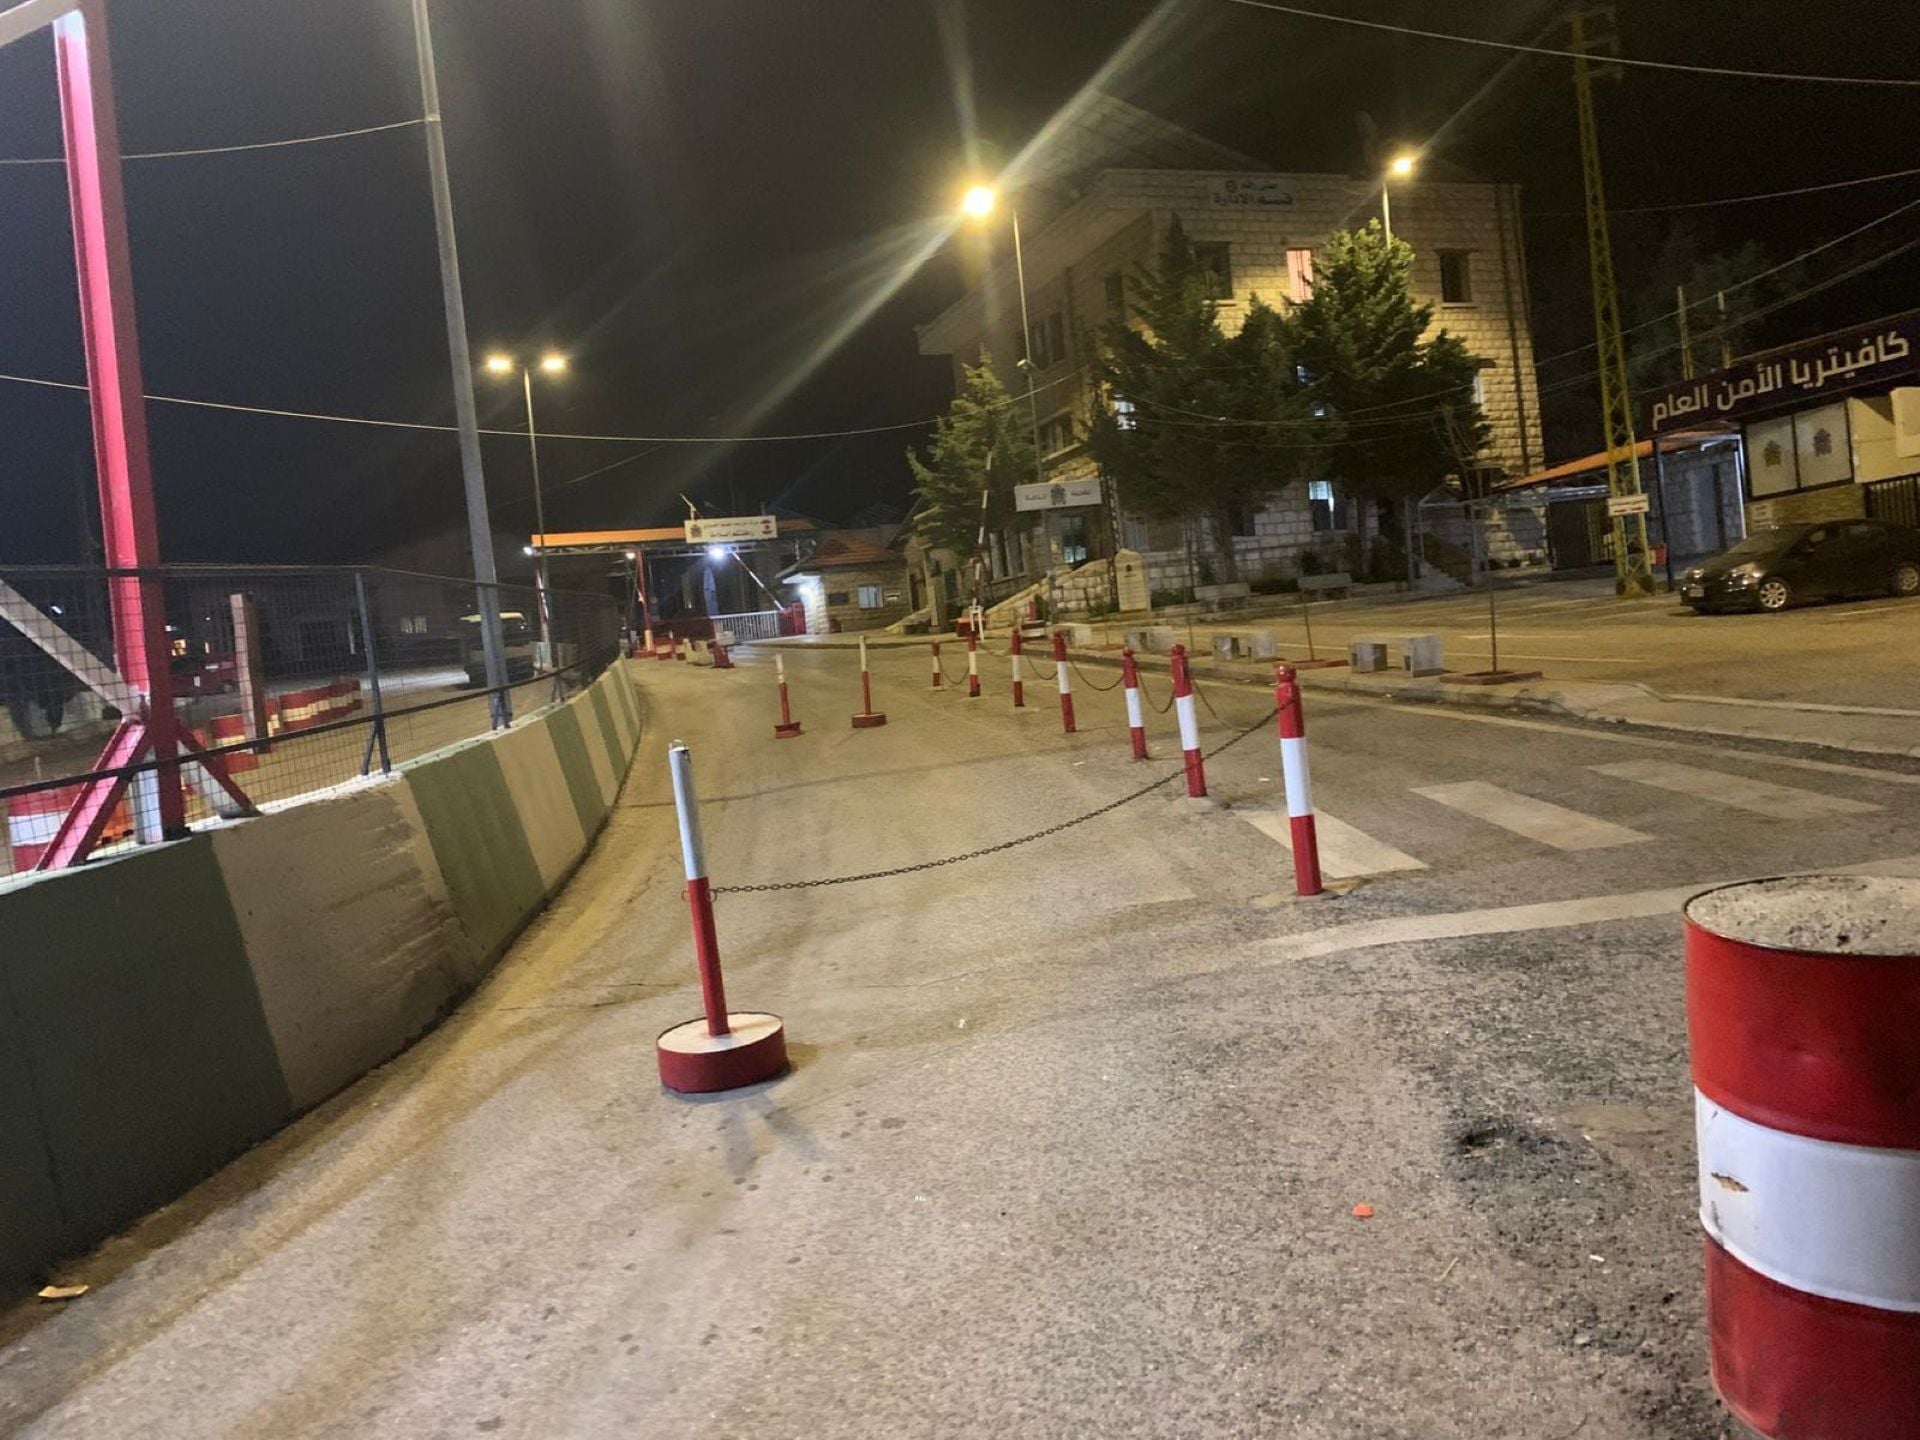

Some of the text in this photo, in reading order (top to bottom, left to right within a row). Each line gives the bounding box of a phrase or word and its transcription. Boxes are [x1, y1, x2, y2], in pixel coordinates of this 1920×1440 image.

[1652, 331, 1909, 431] كافيتريا الأمن العام
